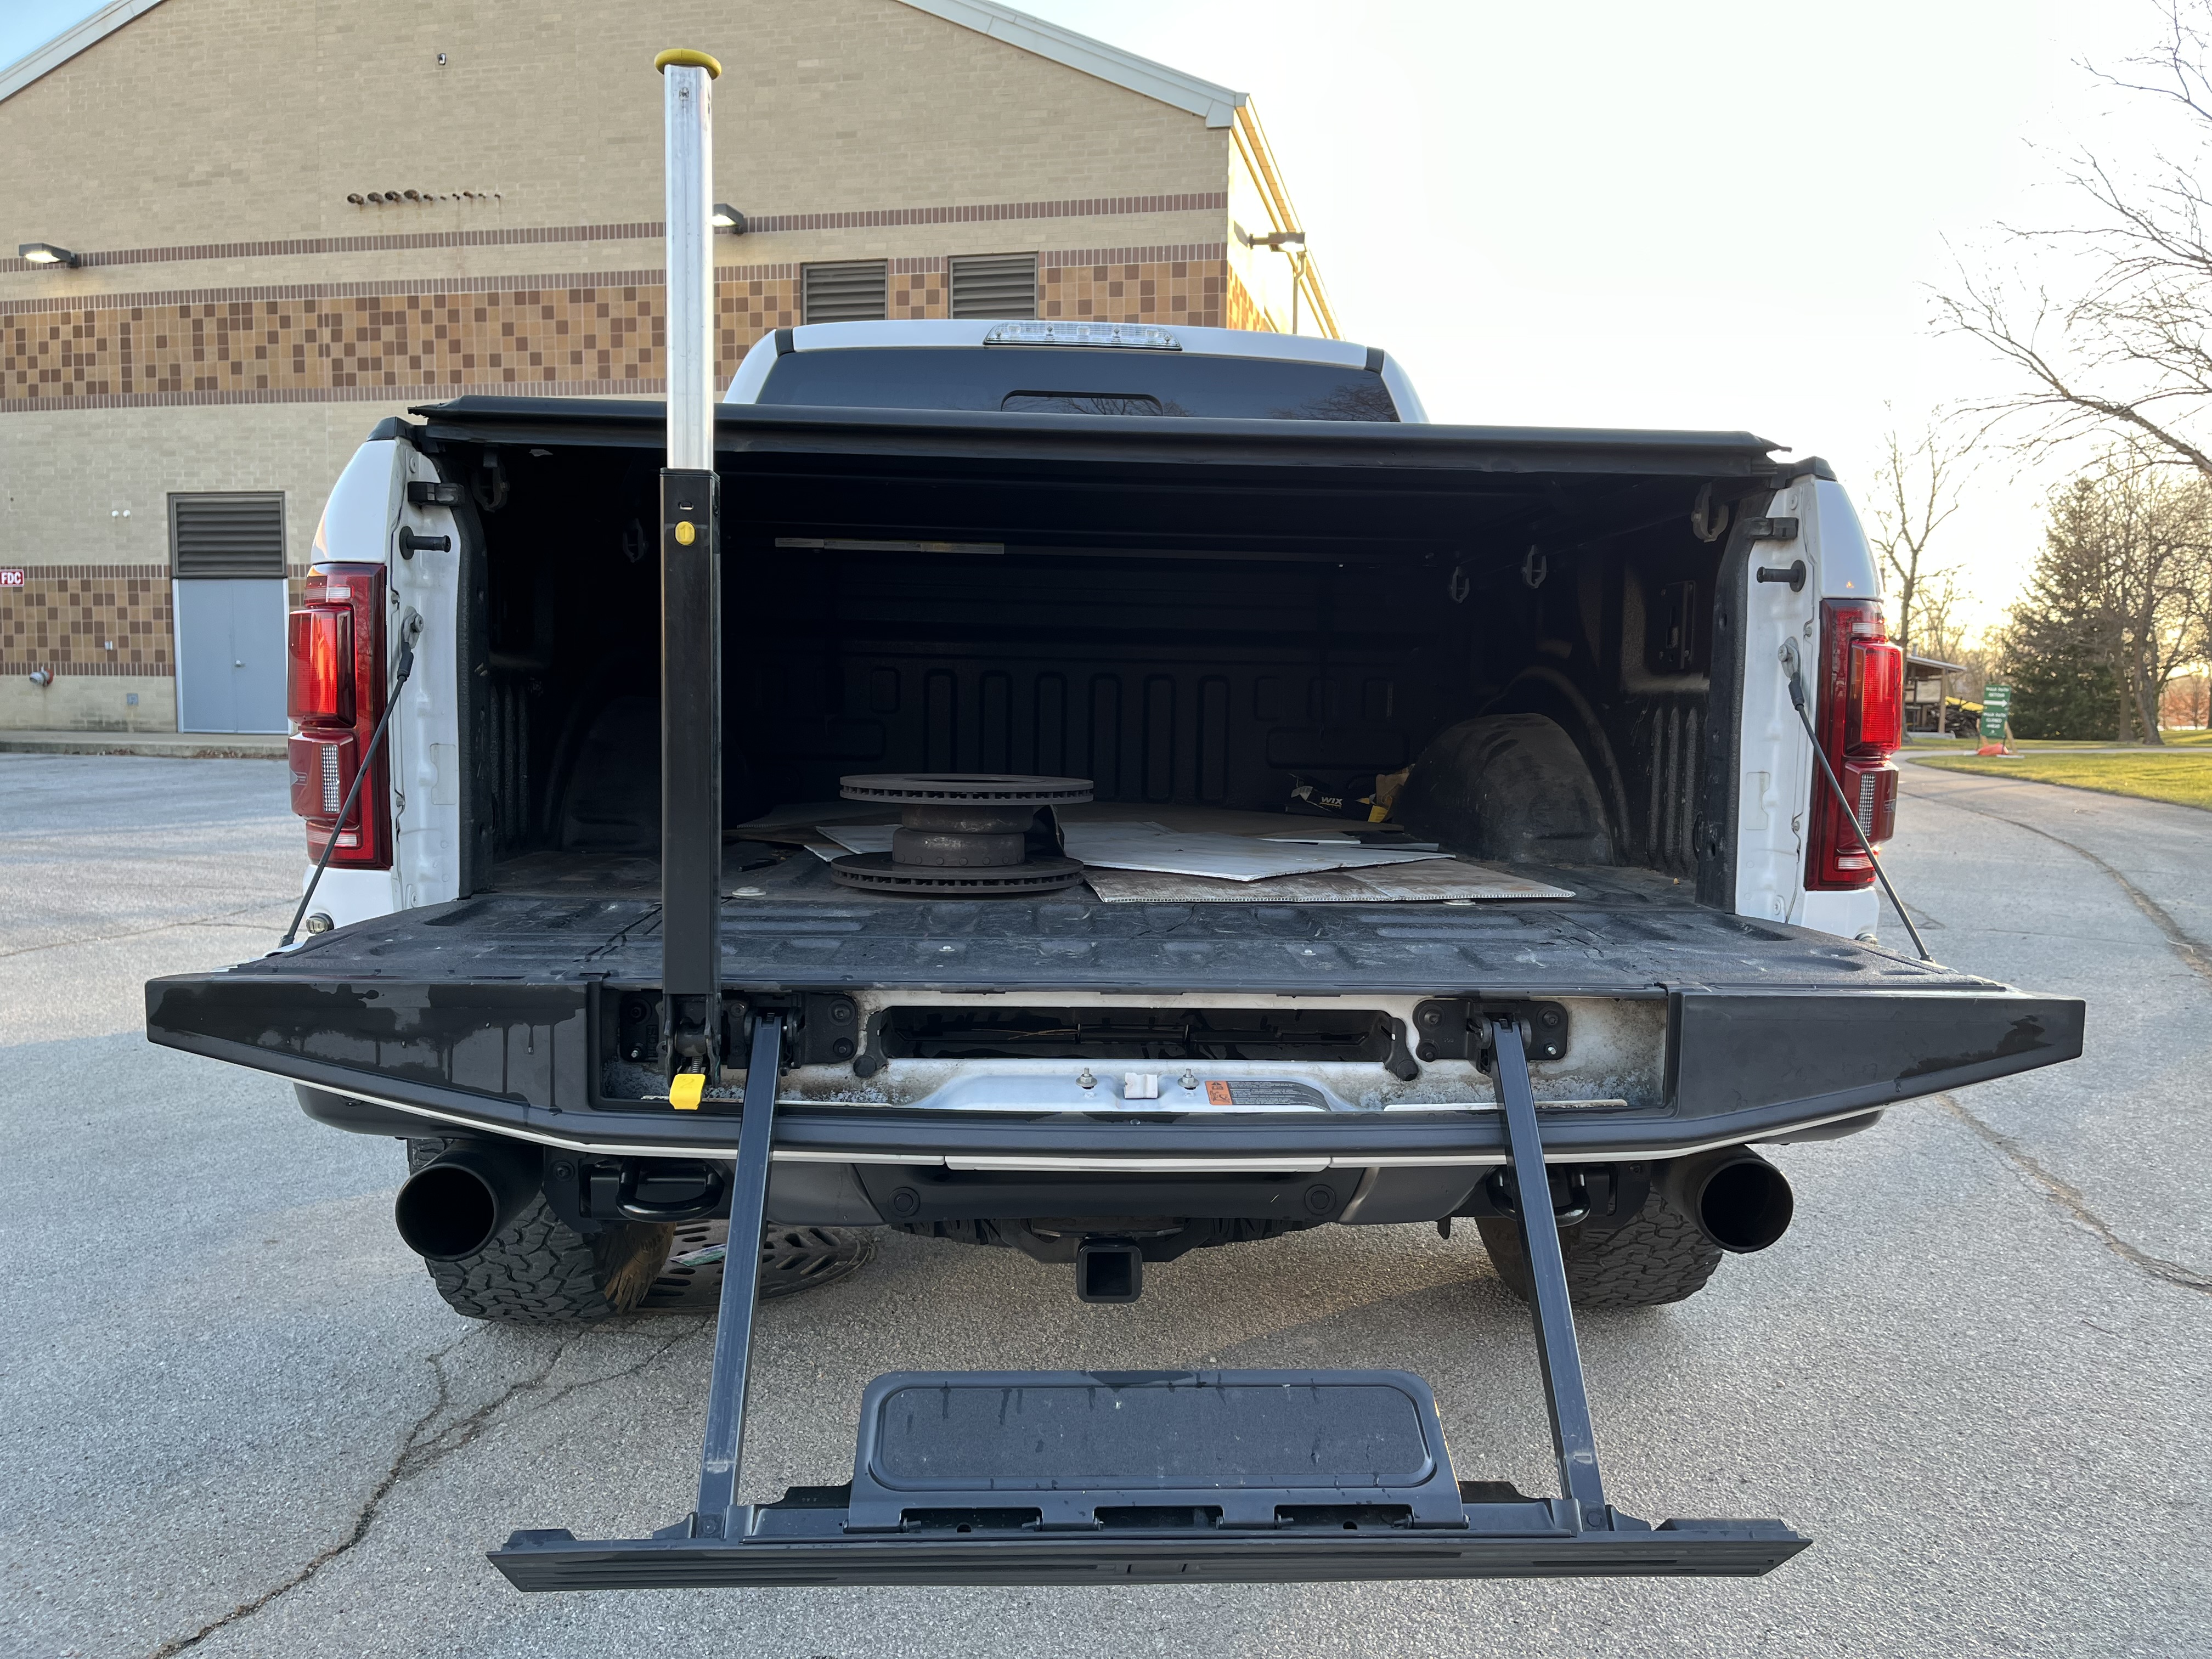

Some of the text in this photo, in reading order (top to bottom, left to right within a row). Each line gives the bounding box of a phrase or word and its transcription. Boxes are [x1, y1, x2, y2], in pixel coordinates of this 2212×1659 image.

[1, 572, 21, 585] FDC
[1321, 797, 1343, 805] WIX
[680, 1077, 695, 1089] 2
